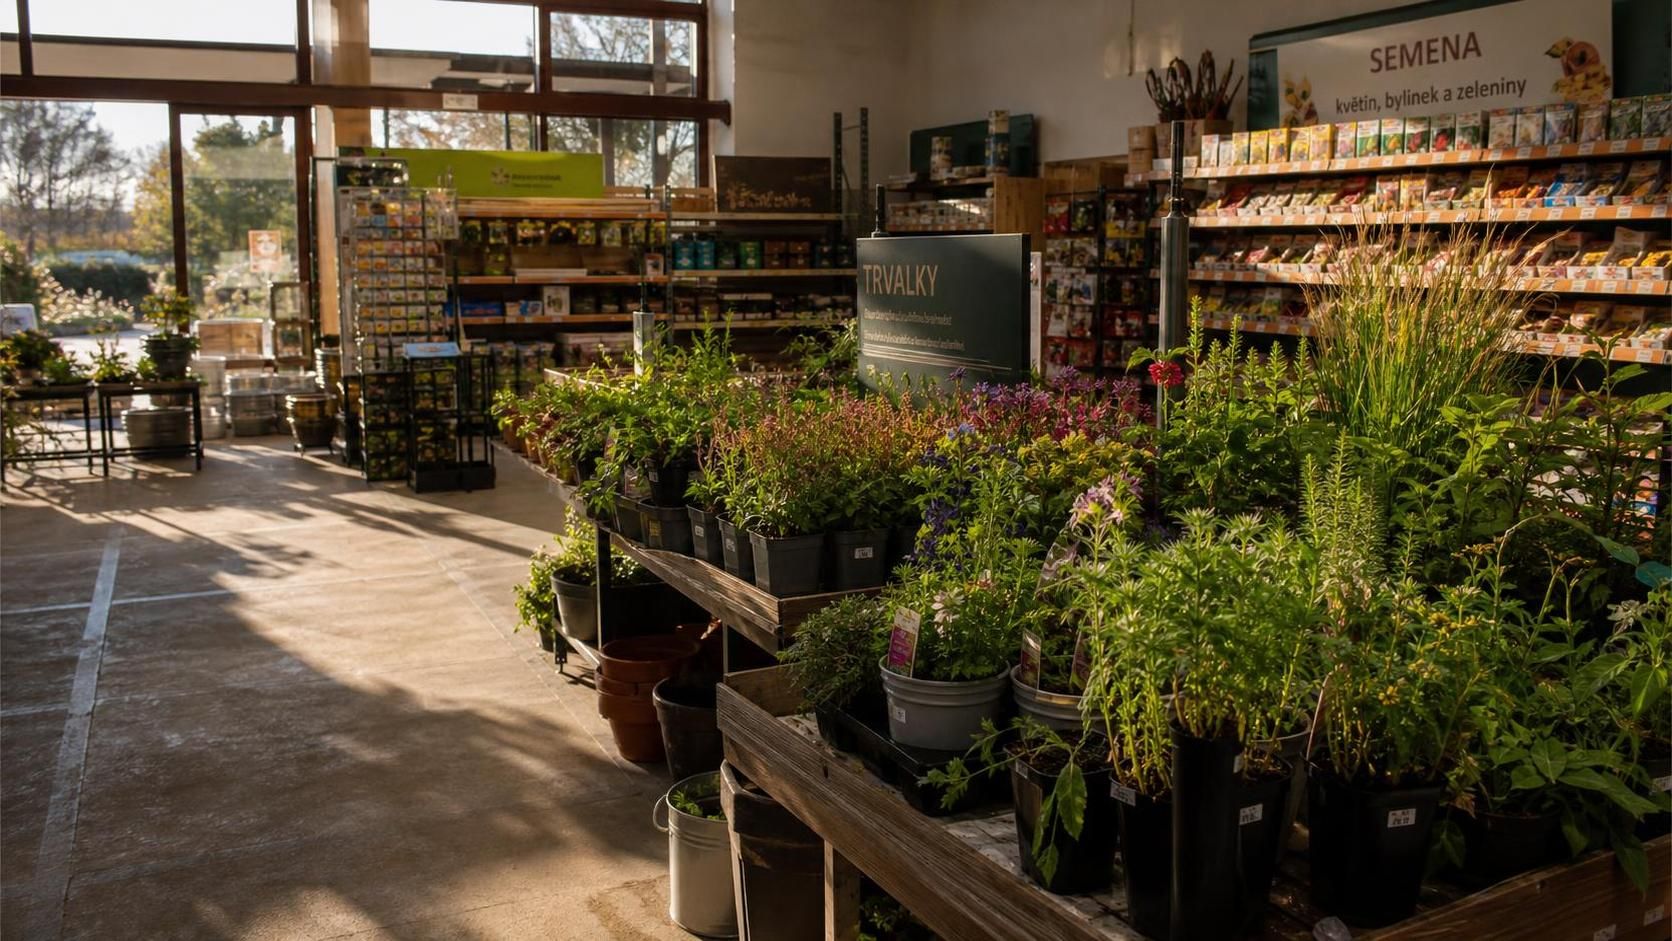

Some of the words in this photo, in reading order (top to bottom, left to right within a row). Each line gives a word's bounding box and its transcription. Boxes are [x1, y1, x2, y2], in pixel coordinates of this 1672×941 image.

[1370, 31, 1482, 74] SEMENA
[1335, 94, 1381, 115] květin,
[1385, 84, 1439, 111] bylinek
[1443, 89, 1452, 102] a
[1456, 77, 1527, 101] zeleniny
[863, 264, 938, 297] TRVALKY
